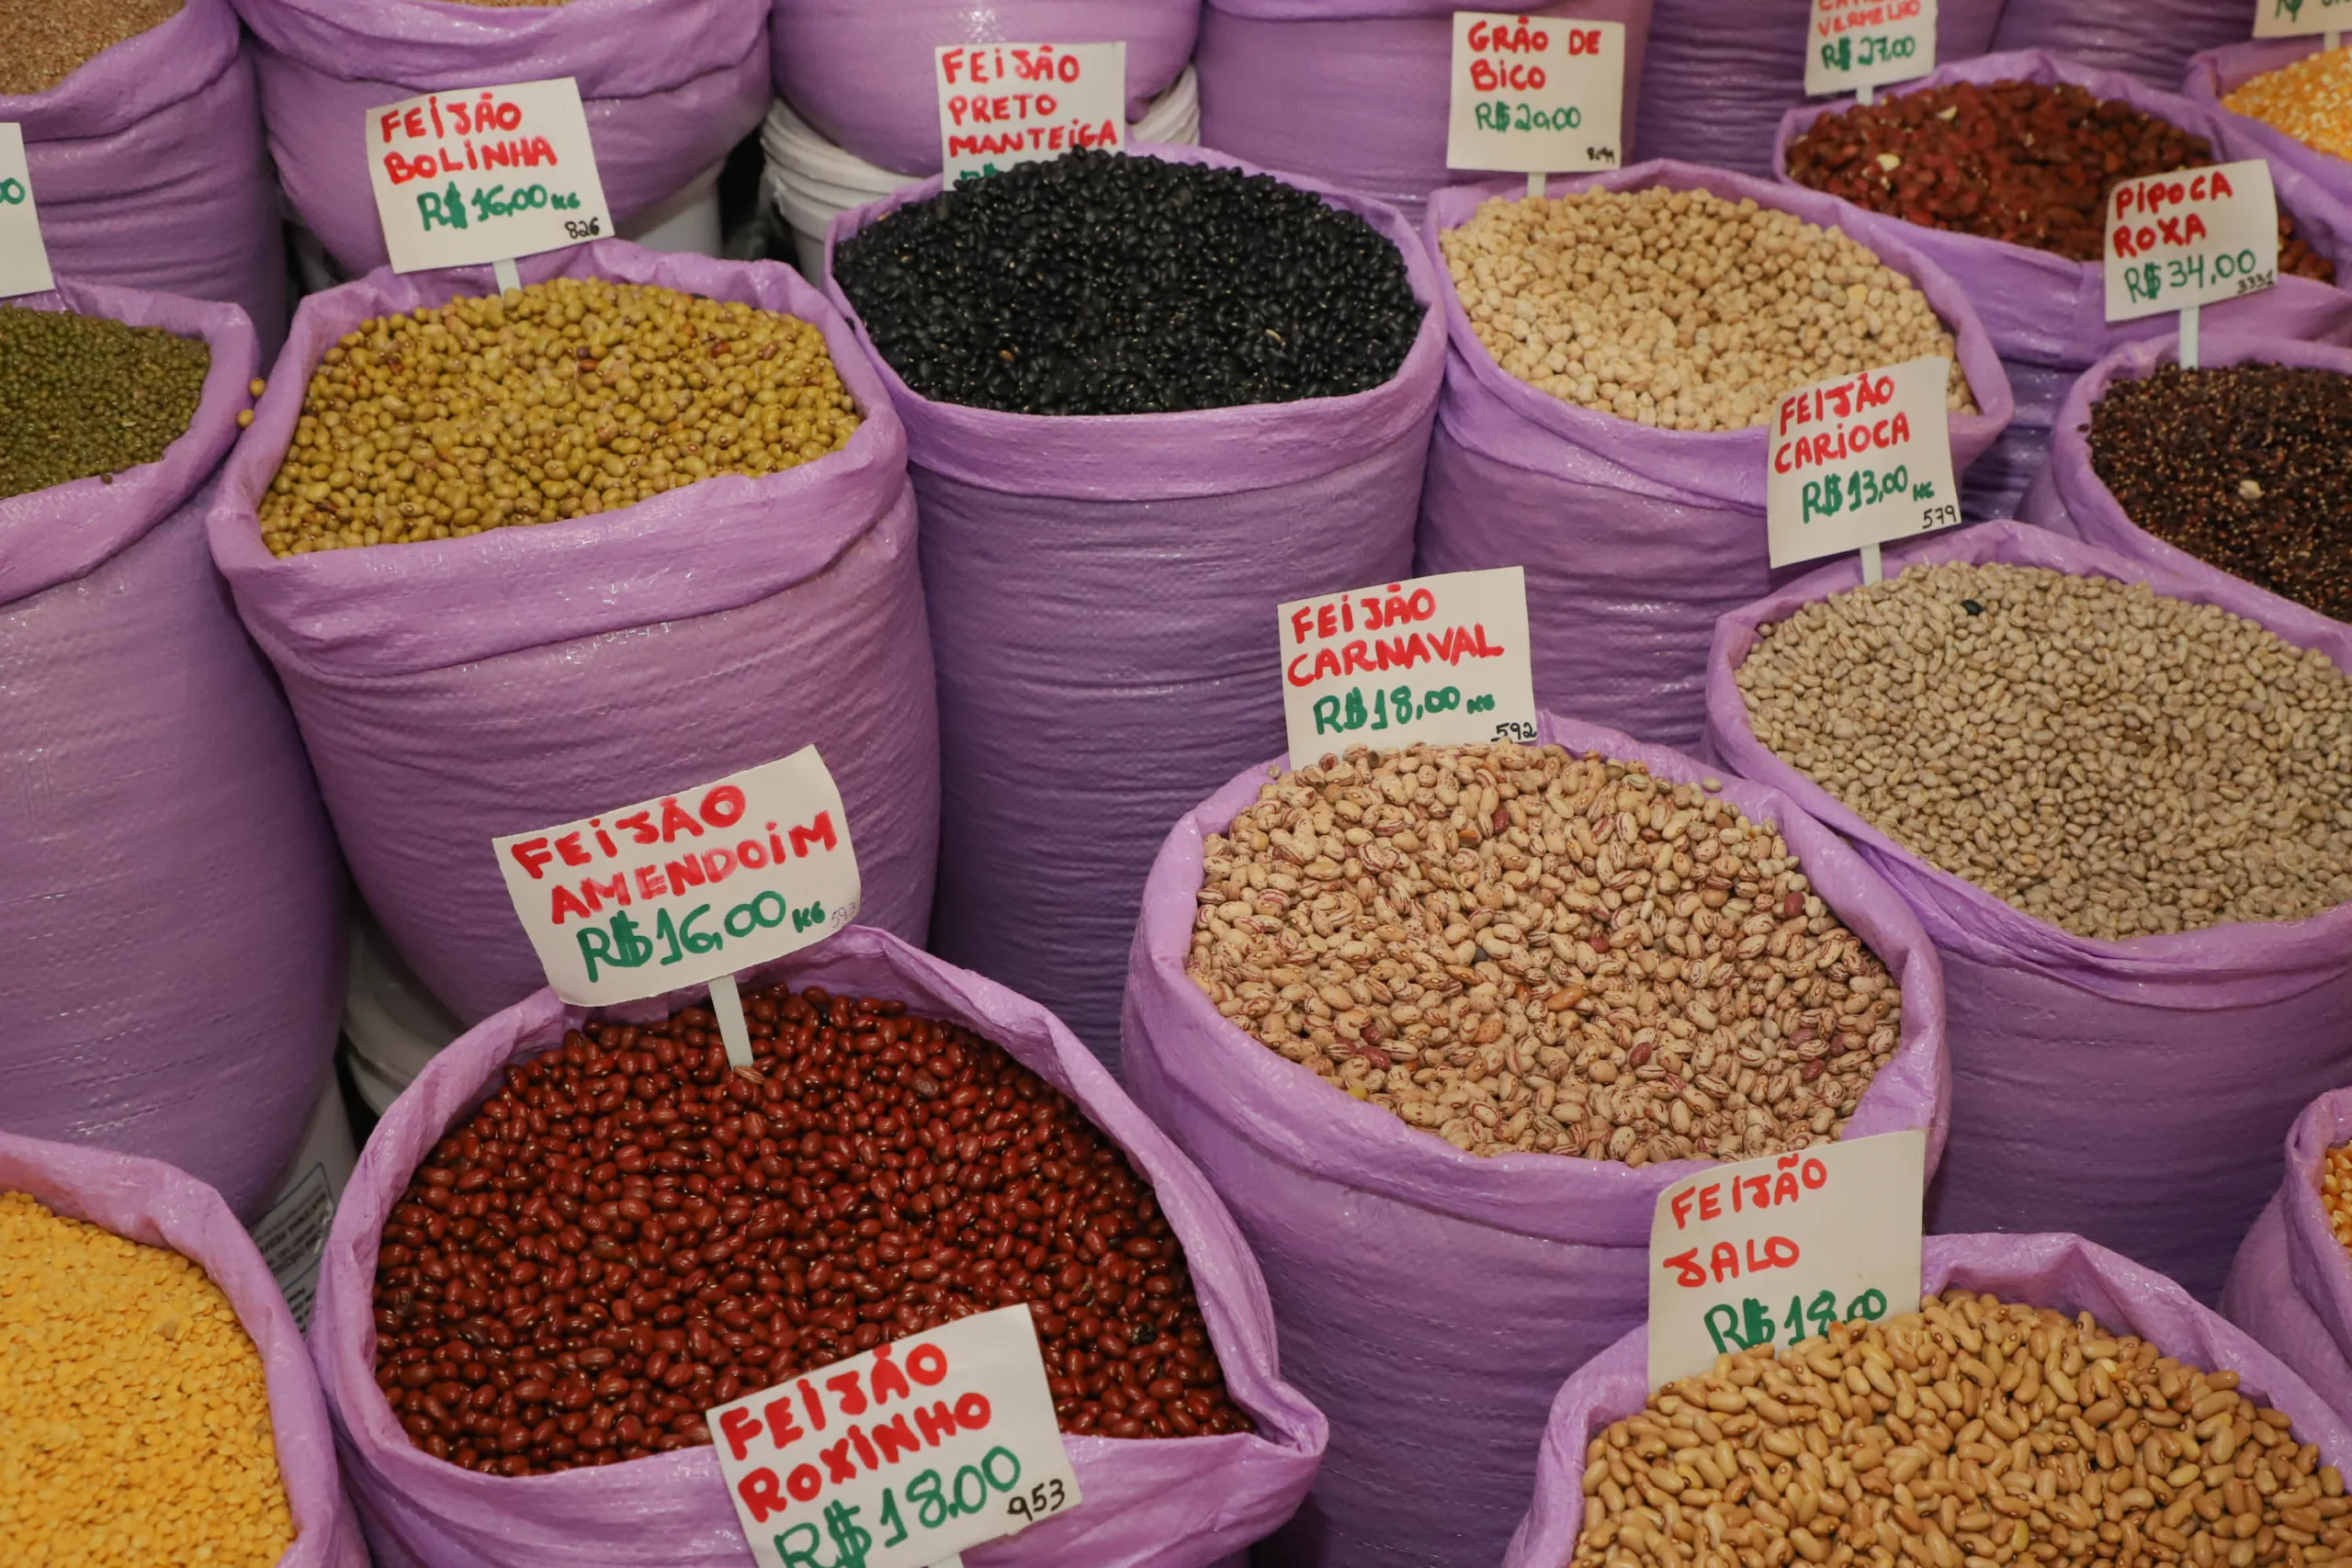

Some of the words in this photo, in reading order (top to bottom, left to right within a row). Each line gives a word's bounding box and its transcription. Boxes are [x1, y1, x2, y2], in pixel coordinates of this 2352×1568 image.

[1468, 16, 1549, 53] GRÃO
[1569, 28, 1601, 56] DE
[948, 94, 1057, 127] PRETO
[383, 135, 558, 185] BOLINHA
[948, 118, 1117, 158] MANTEIGA
[2116, 171, 2233, 220] PIPOCA
[564, 217, 600, 239] 826
[2113, 213, 2207, 259] ROXA
[1781, 372, 1894, 436] FEIJÃO
[1774, 412, 1910, 474] CARIOCA
[1922, 504, 1957, 529] 579
[1287, 623, 1504, 687] CARNAVAL
[1490, 722, 1537, 742] 592
[551, 810, 838, 925] AMENDOIM
[1671, 1153, 1827, 1230] FEIJÃO
[1662, 1235, 1800, 1288] JALO
[719, 1343, 948, 1461] FEIJÃO
[737, 1392, 991, 1523] ROXINHO
[1007, 1479, 1065, 1521] 953
